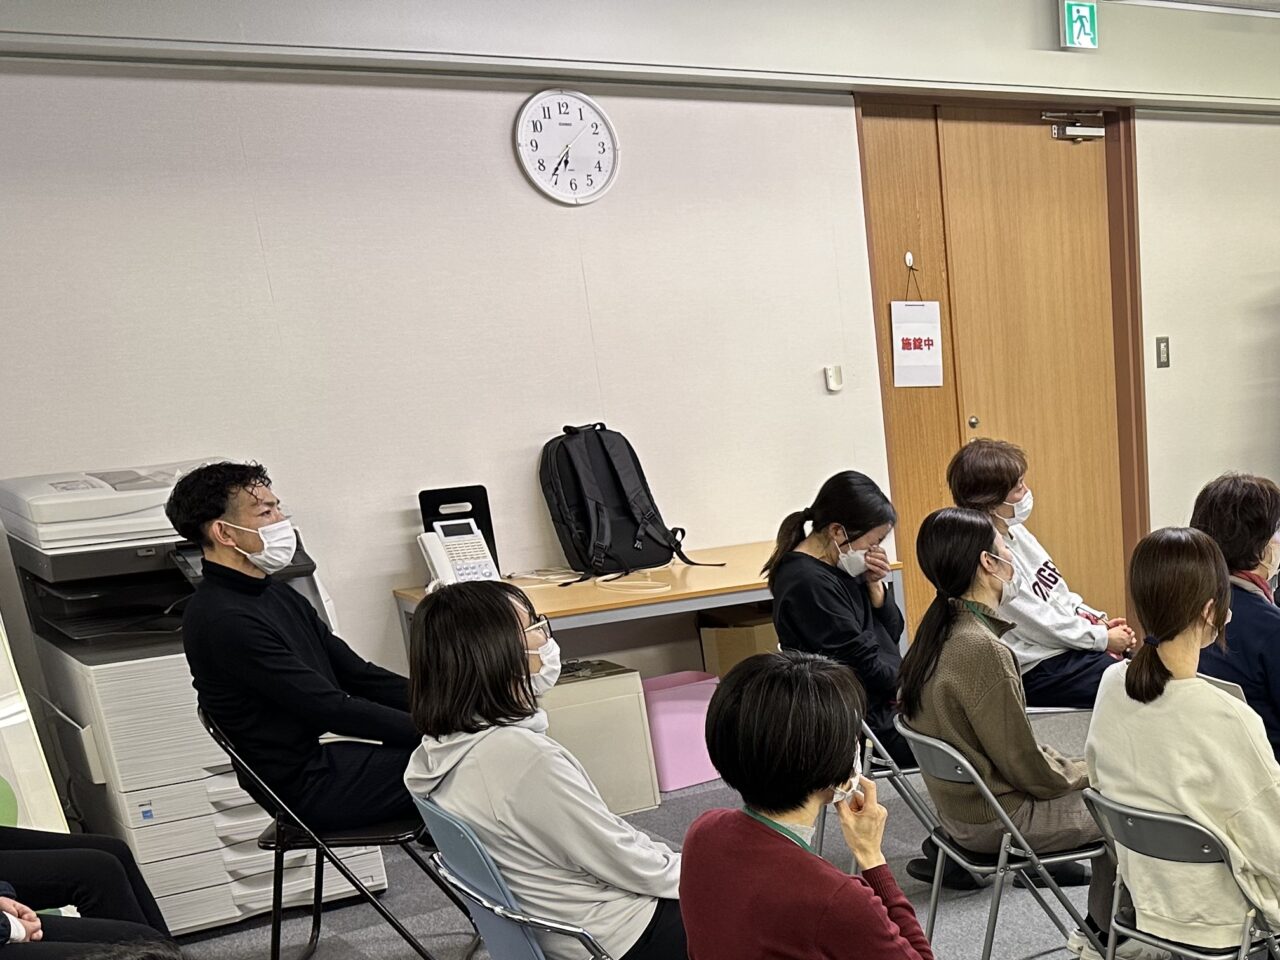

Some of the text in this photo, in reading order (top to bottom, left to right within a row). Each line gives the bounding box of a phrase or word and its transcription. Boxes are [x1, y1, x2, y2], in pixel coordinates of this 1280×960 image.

[542, 106, 551, 119] 11
[557, 102, 569, 115] 12
[578, 108, 583, 120] 1
[531, 120, 543, 133] 10
[591, 122, 599, 135] 2
[530, 139, 538, 152] 9
[598, 142, 606, 154] 3
[537, 158, 546, 171] 8
[594, 160, 602, 172] 4
[552, 173, 559, 185] 7
[569, 178, 578, 191] 6
[586, 174, 593, 186] 5
[901, 336, 934, 351] 施錠中
